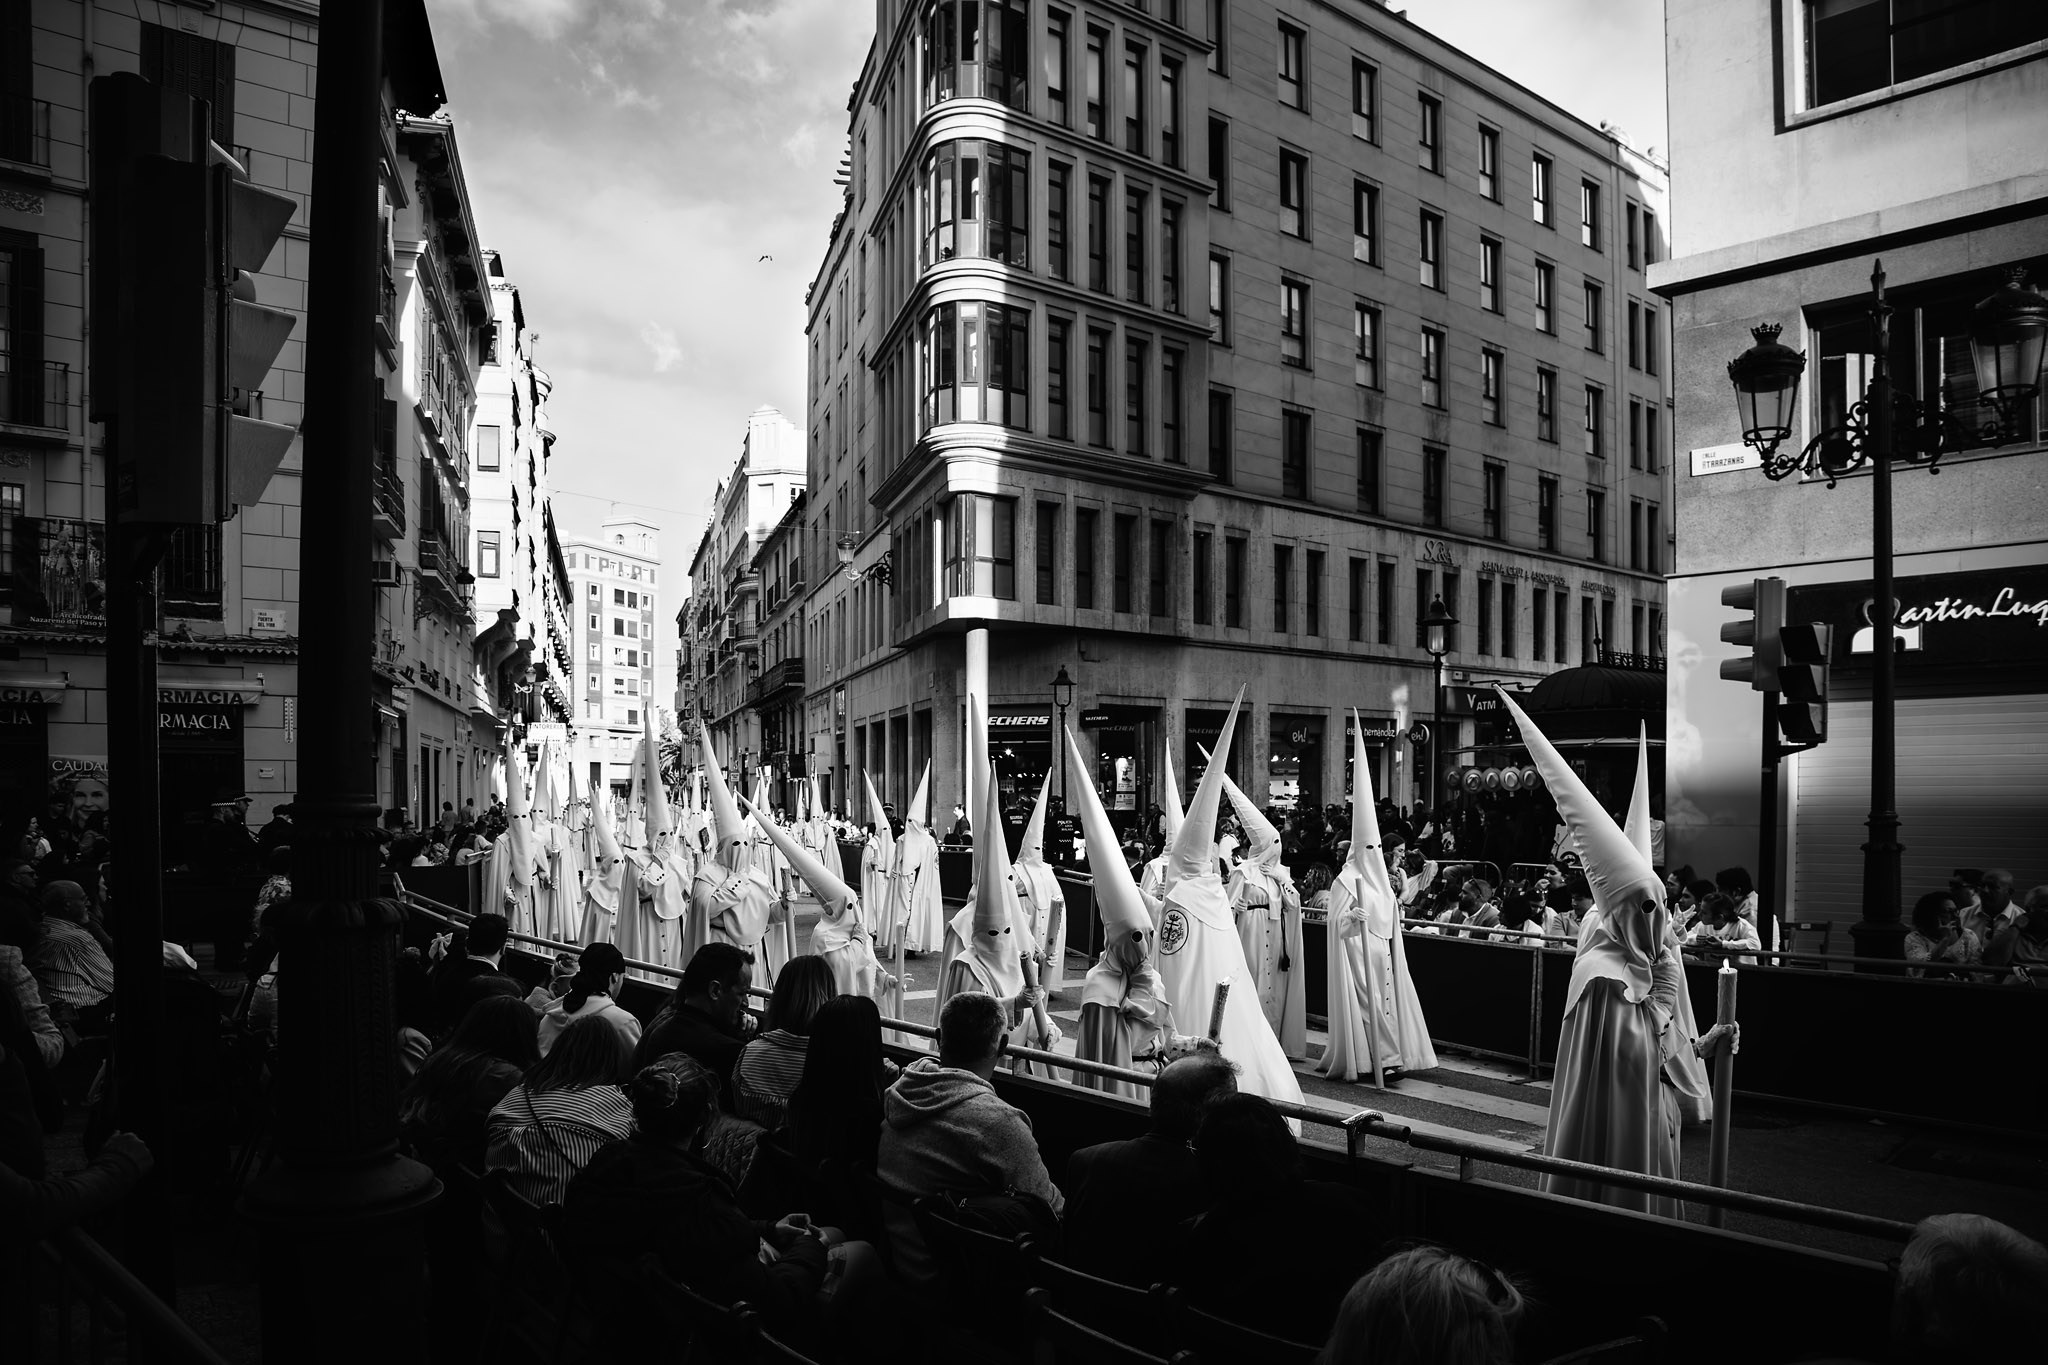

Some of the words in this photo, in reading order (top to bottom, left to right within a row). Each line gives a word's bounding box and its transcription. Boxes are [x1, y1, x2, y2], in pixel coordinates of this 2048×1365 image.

[1899, 597, 1985, 624] artín
[80, 619, 98, 627] Paso
[158, 690, 244, 705] RMACIA
[159, 713, 232, 730] RMACIA
[987, 715, 1051, 727] ECHERS
